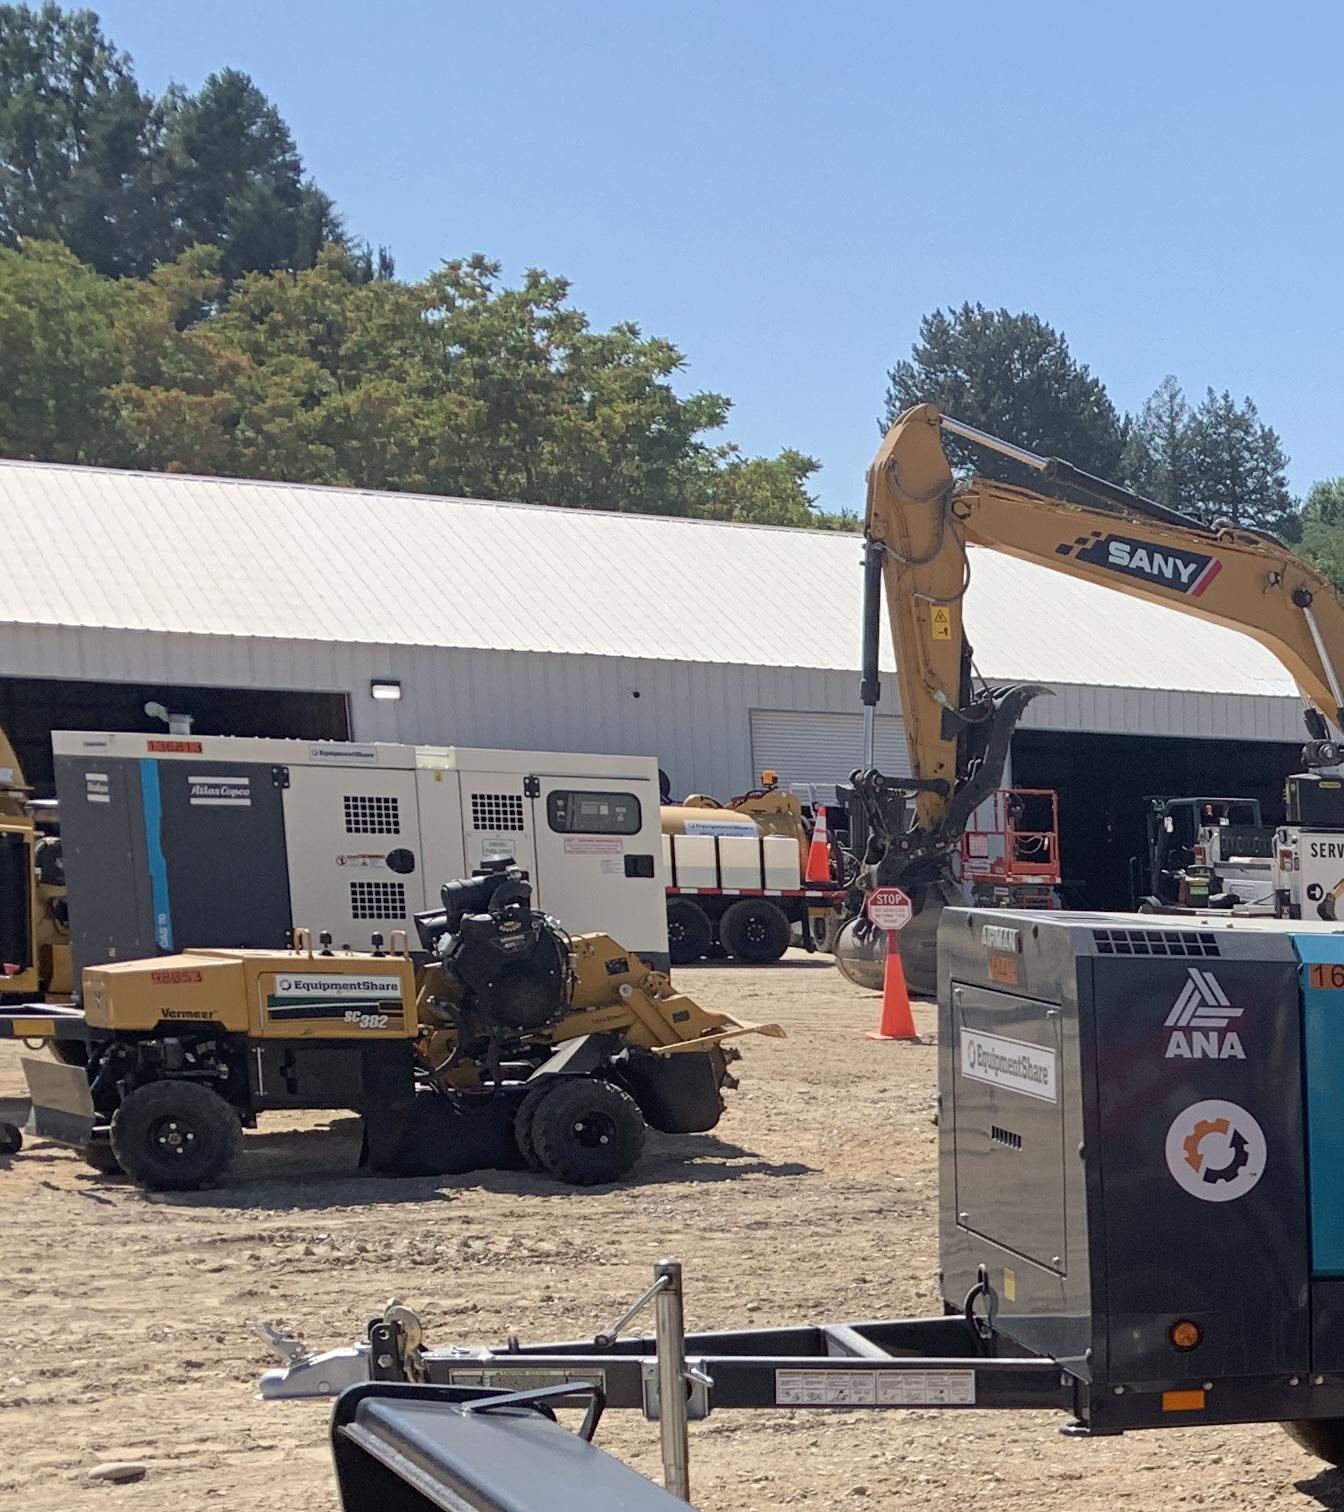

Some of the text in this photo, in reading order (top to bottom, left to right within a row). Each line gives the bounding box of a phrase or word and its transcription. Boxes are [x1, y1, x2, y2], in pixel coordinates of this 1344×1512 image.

[1108, 541, 1197, 584] SANY
[192, 784, 250, 797] Atlas Copco
[876, 894, 902, 905] STOP
[294, 980, 398, 992] EquipmentShare
[161, 1008, 215, 1020] Vermeer
[344, 1010, 388, 1028] SC382
[1164, 1030, 1247, 1059] ANA
[976, 1043, 1049, 1085] EquipmentShare
